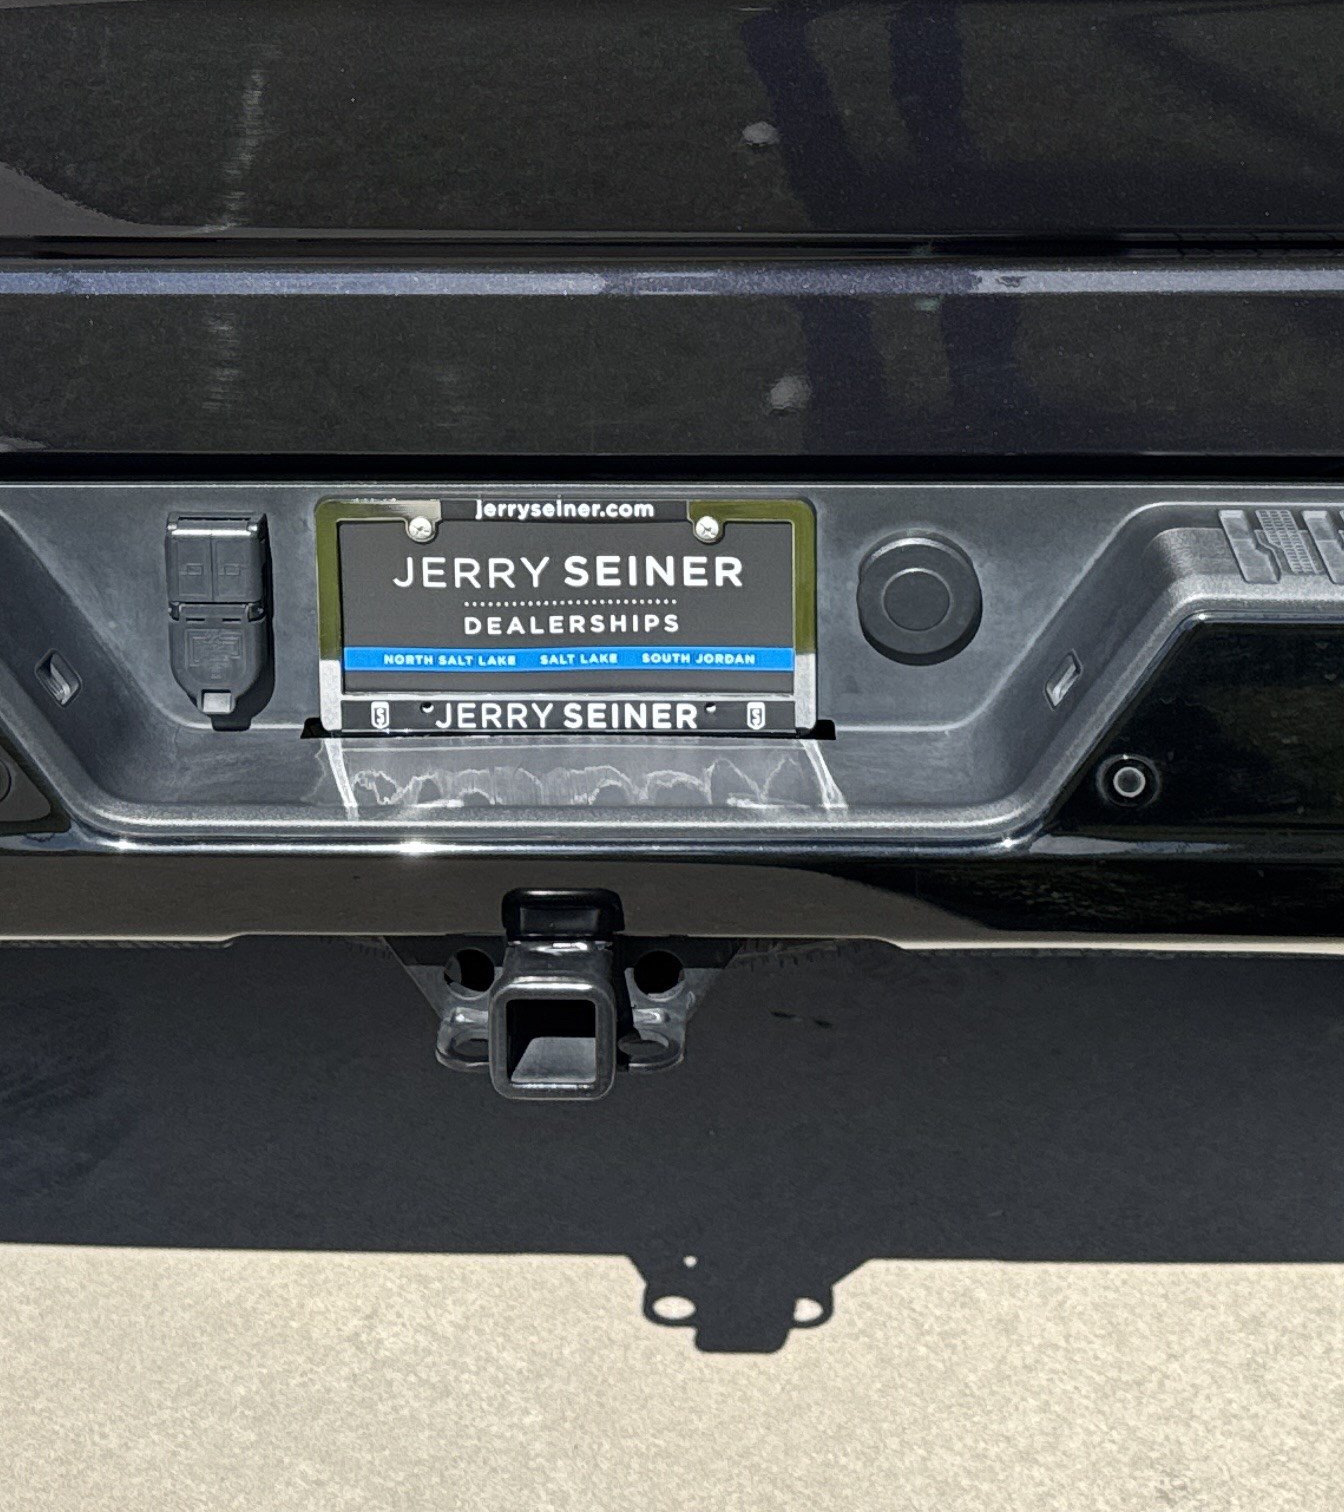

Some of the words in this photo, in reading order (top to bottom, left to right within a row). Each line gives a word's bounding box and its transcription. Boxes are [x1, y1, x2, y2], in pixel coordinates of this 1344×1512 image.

[475, 499, 655, 521] jerryseiner.com
[392, 555, 550, 589] JERRY
[564, 555, 743, 587] SEINER
[464, 614, 679, 635] DEALERSHIPS
[383, 654, 433, 666] NORTH
[438, 655, 473, 666] SALT
[478, 655, 516, 666] LAKE
[539, 653, 574, 665] SALT
[580, 653, 618, 664] LAKE
[642, 652, 690, 664] SOUTH
[695, 653, 755, 664] JORDAN
[435, 702, 553, 729] JERRY
[563, 702, 697, 729] SEINER
